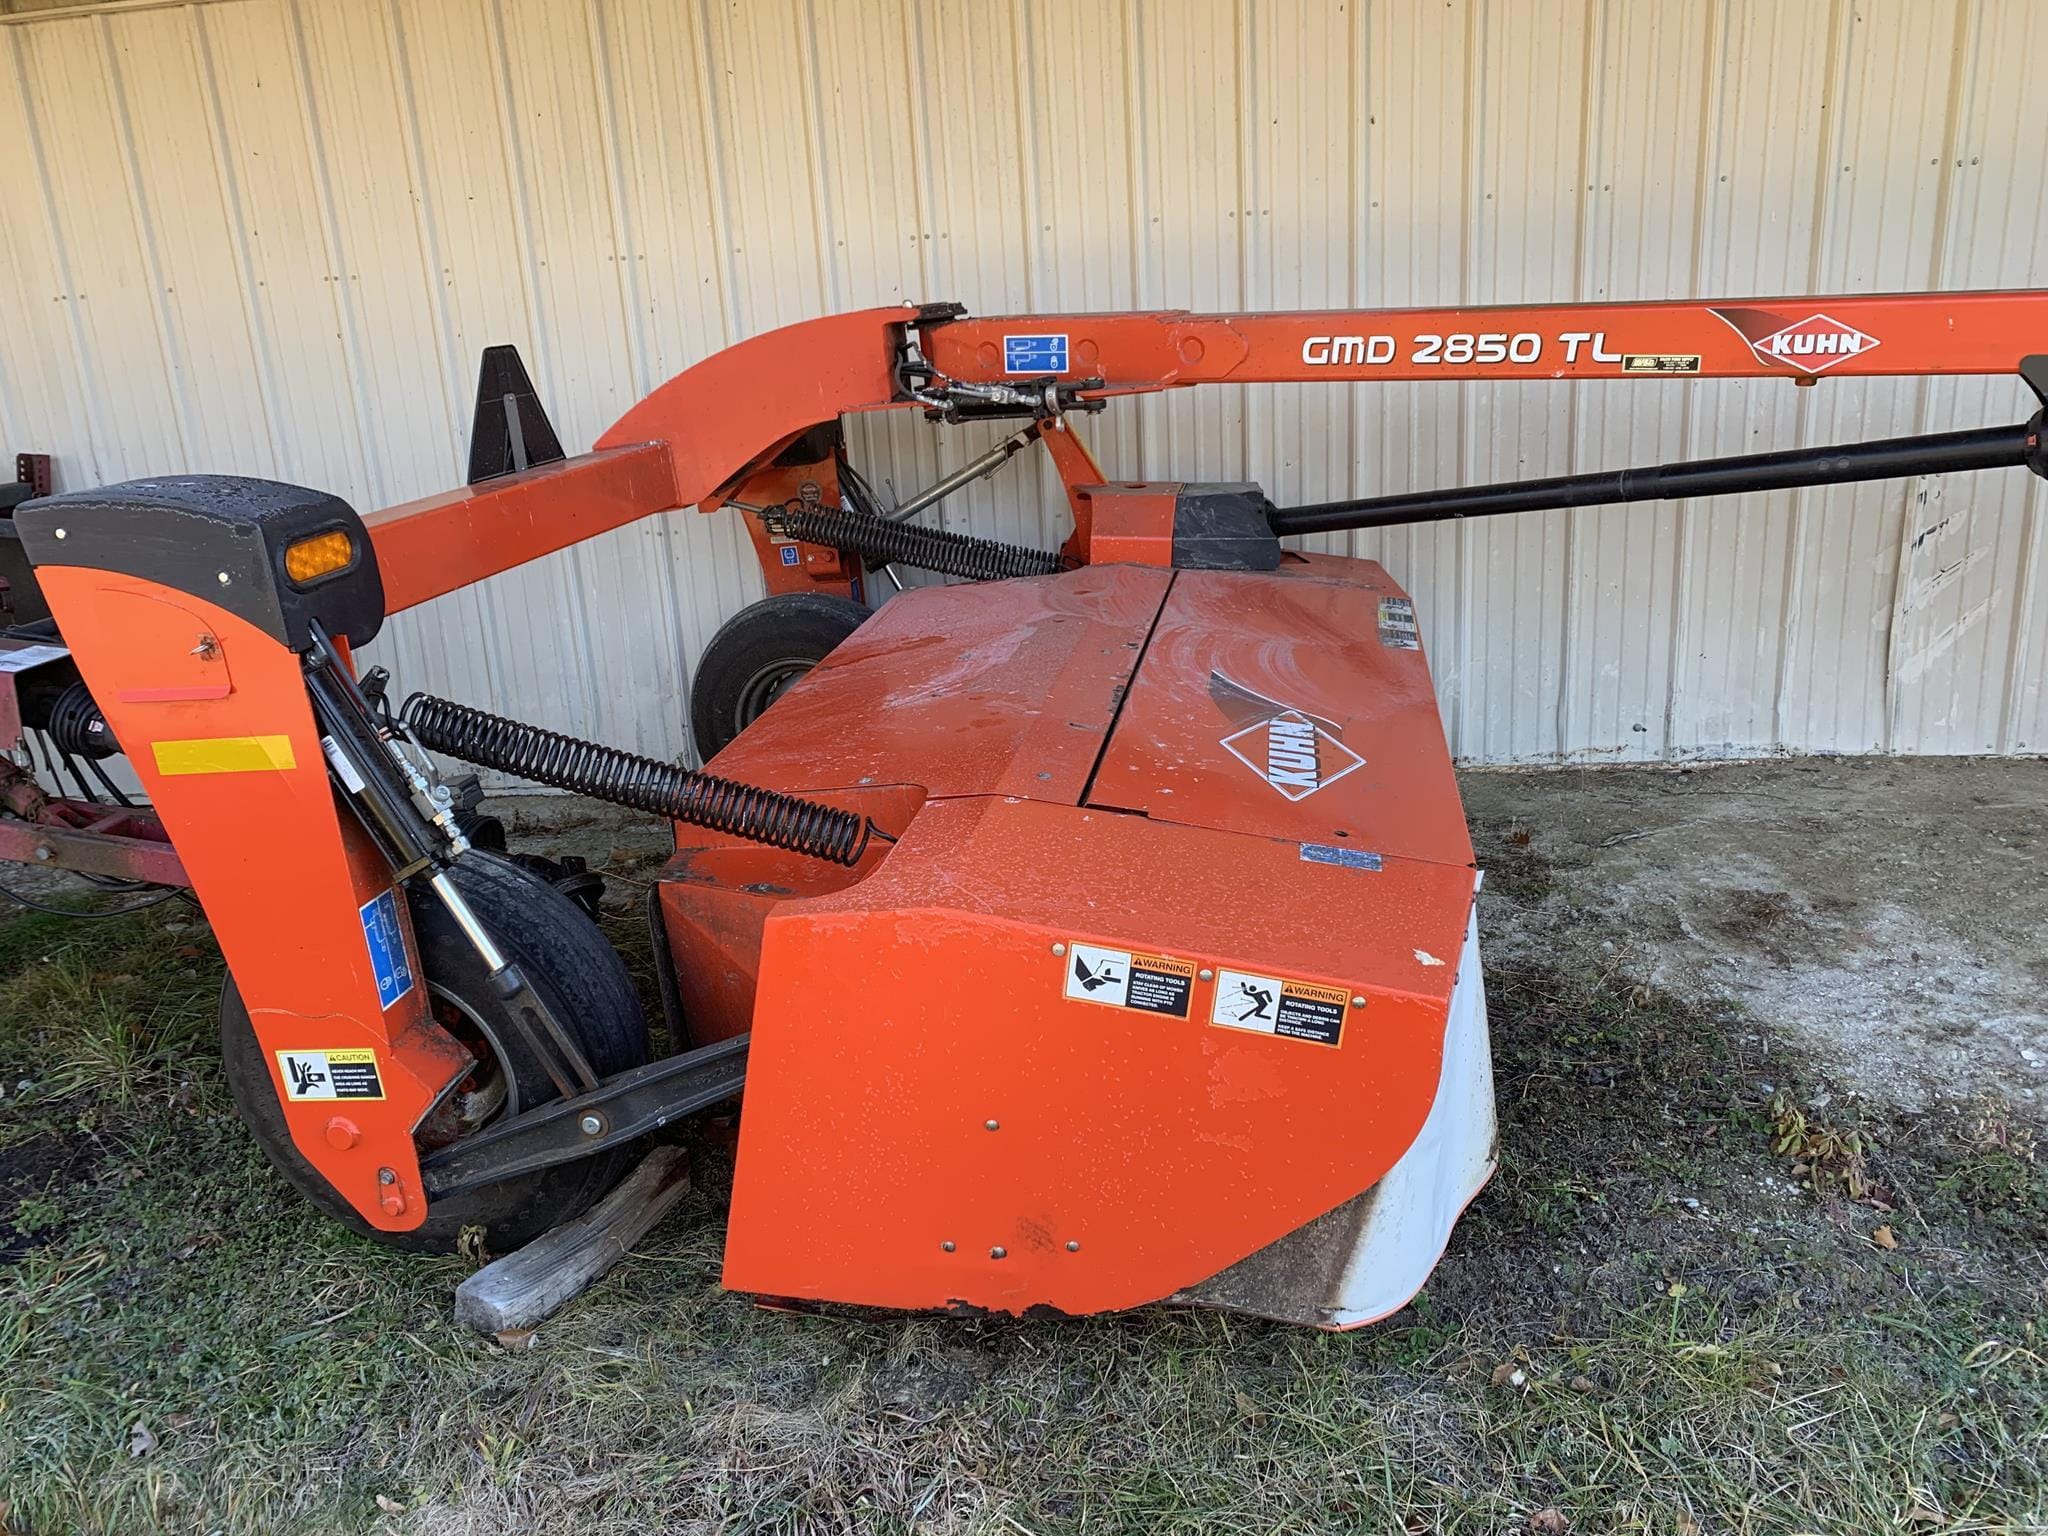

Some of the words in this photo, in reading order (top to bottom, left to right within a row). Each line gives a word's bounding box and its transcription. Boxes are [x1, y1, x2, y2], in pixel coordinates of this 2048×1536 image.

[1302, 335, 1396, 365] GMD
[1411, 333, 1542, 364] 2850
[1558, 332, 1623, 363] TL
[1771, 333, 1862, 355] KUHN
[1268, 720, 1319, 788] KUHN
[1143, 959, 1191, 974] WARNING
[1135, 972, 1165, 983] ROTATING
[1165, 977, 1185, 986] TOOLS
[1294, 986, 1344, 1002] WARNING
[1285, 1000, 1316, 1011] ROTATING
[1317, 1006, 1338, 1014] TOOLS
